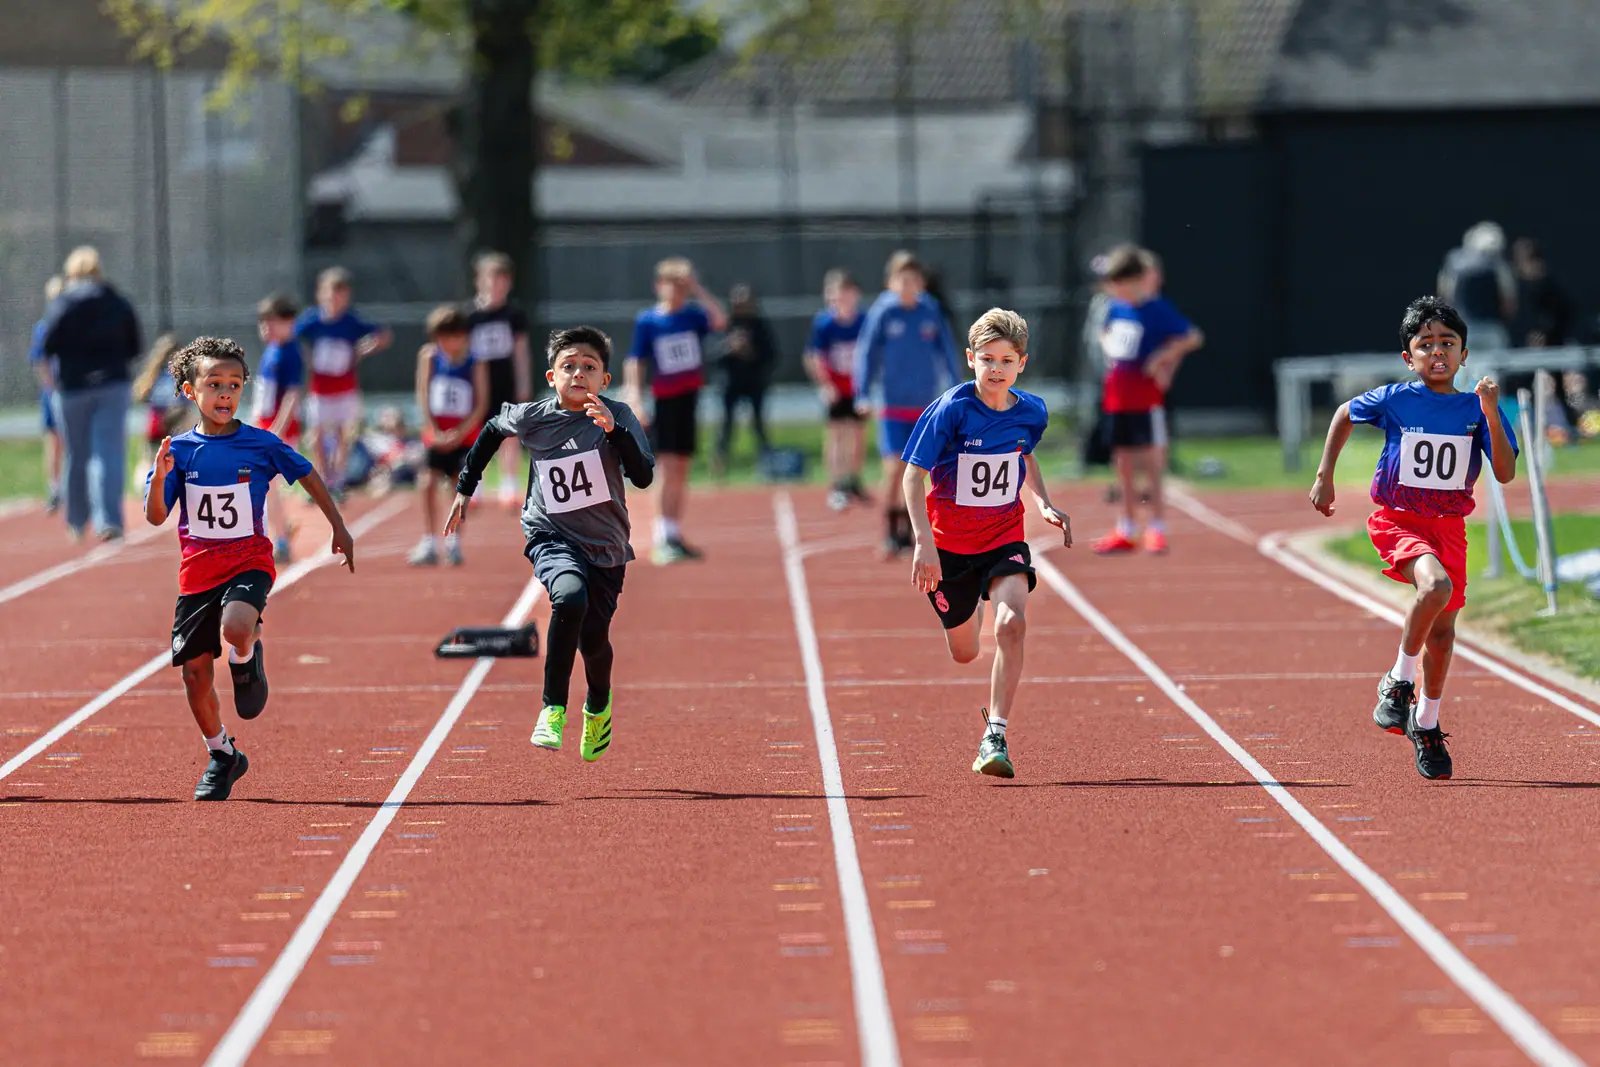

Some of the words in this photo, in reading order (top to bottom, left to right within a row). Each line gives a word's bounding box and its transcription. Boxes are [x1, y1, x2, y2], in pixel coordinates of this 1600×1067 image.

[971, 460, 1010, 498] 94
[1413, 440, 1457, 481] 90
[548, 460, 593, 503] 84
[197, 492, 239, 529] 43
